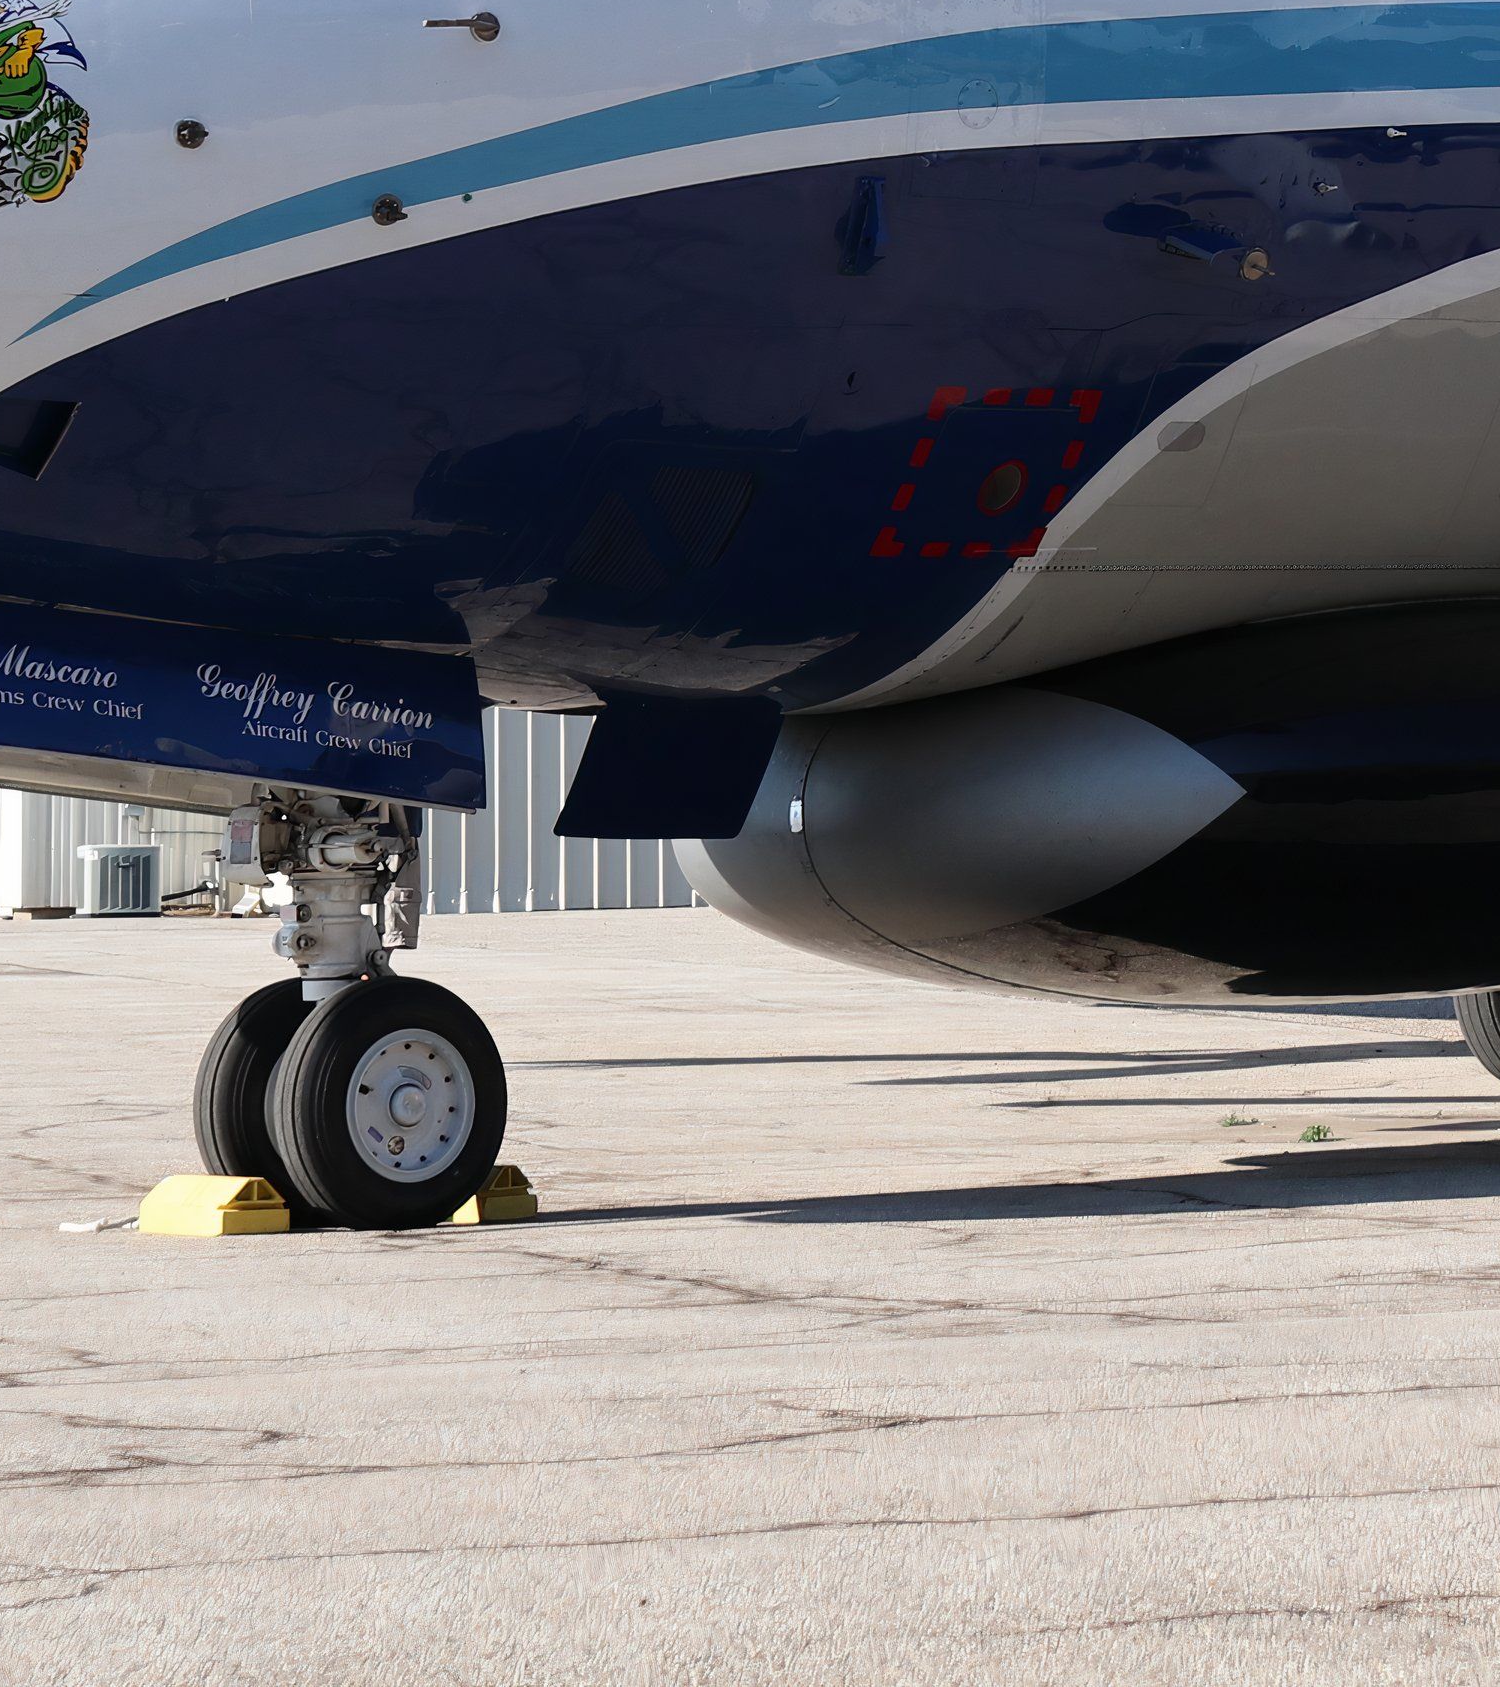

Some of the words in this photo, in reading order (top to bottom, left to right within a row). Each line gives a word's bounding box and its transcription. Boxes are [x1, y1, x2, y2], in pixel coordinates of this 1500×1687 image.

[31, 691, 86, 711] Crew
[92, 698, 144, 720] Chief
[196, 663, 314, 724] Geoffrey
[327, 681, 434, 729] Carrion
[241, 720, 309, 743] Aircraft
[315, 729, 363, 750] Crew
[367, 736, 413, 758] Chief
